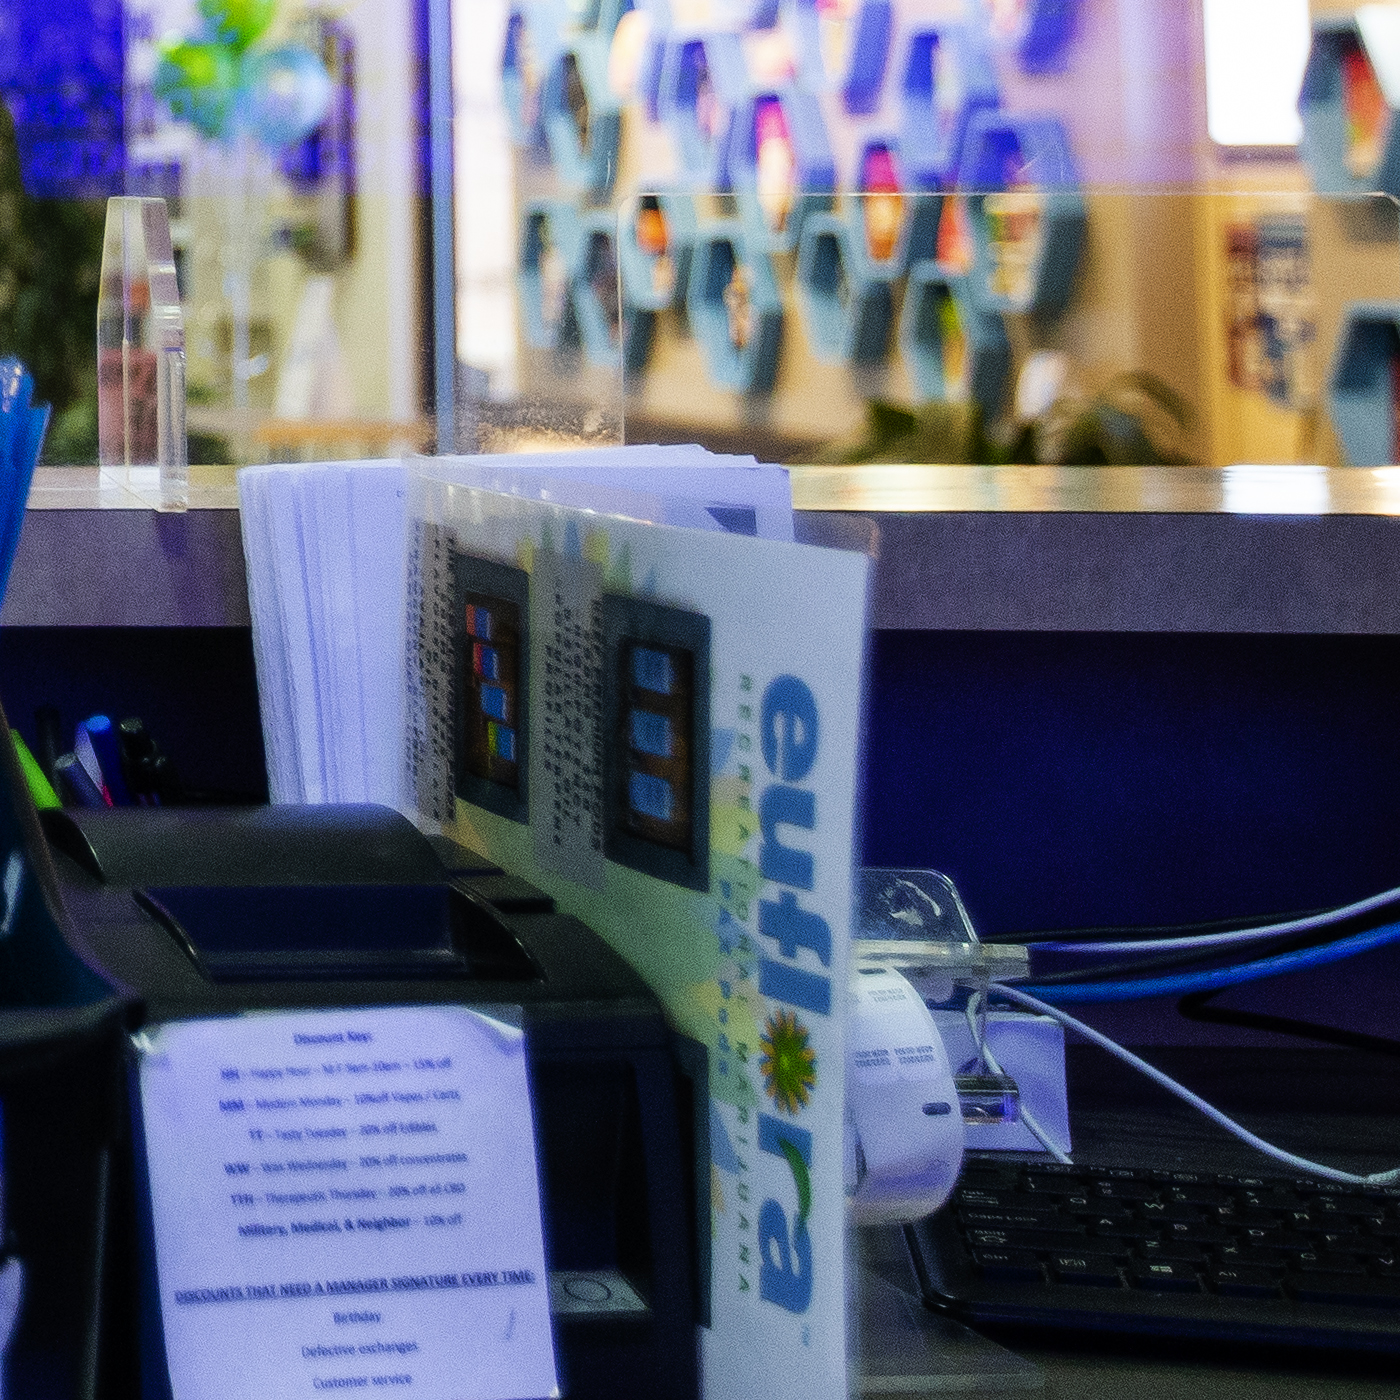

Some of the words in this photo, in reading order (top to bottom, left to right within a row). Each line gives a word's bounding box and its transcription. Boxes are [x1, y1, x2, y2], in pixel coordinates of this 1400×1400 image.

[738, 674, 752, 1005] RECREATIONAL
[737, 1041, 750, 1293] MARIJUANA
[175, 1286, 244, 1305] DISCOUNTS
[245, 1284, 278, 1300] THAT
[280, 1282, 312, 1299] NEED
[326, 1277, 388, 1296] MANAGER
[389, 1274, 460, 1293] SIGNATURE
[461, 1272, 500, 1289] EVERY
[333, 1310, 382, 1326] Birthday
[301, 1342, 355, 1360] Defective
[357, 1338, 419, 1357] exchanges
[312, 1374, 368, 1391] Customer
[371, 1371, 413, 1387] service
